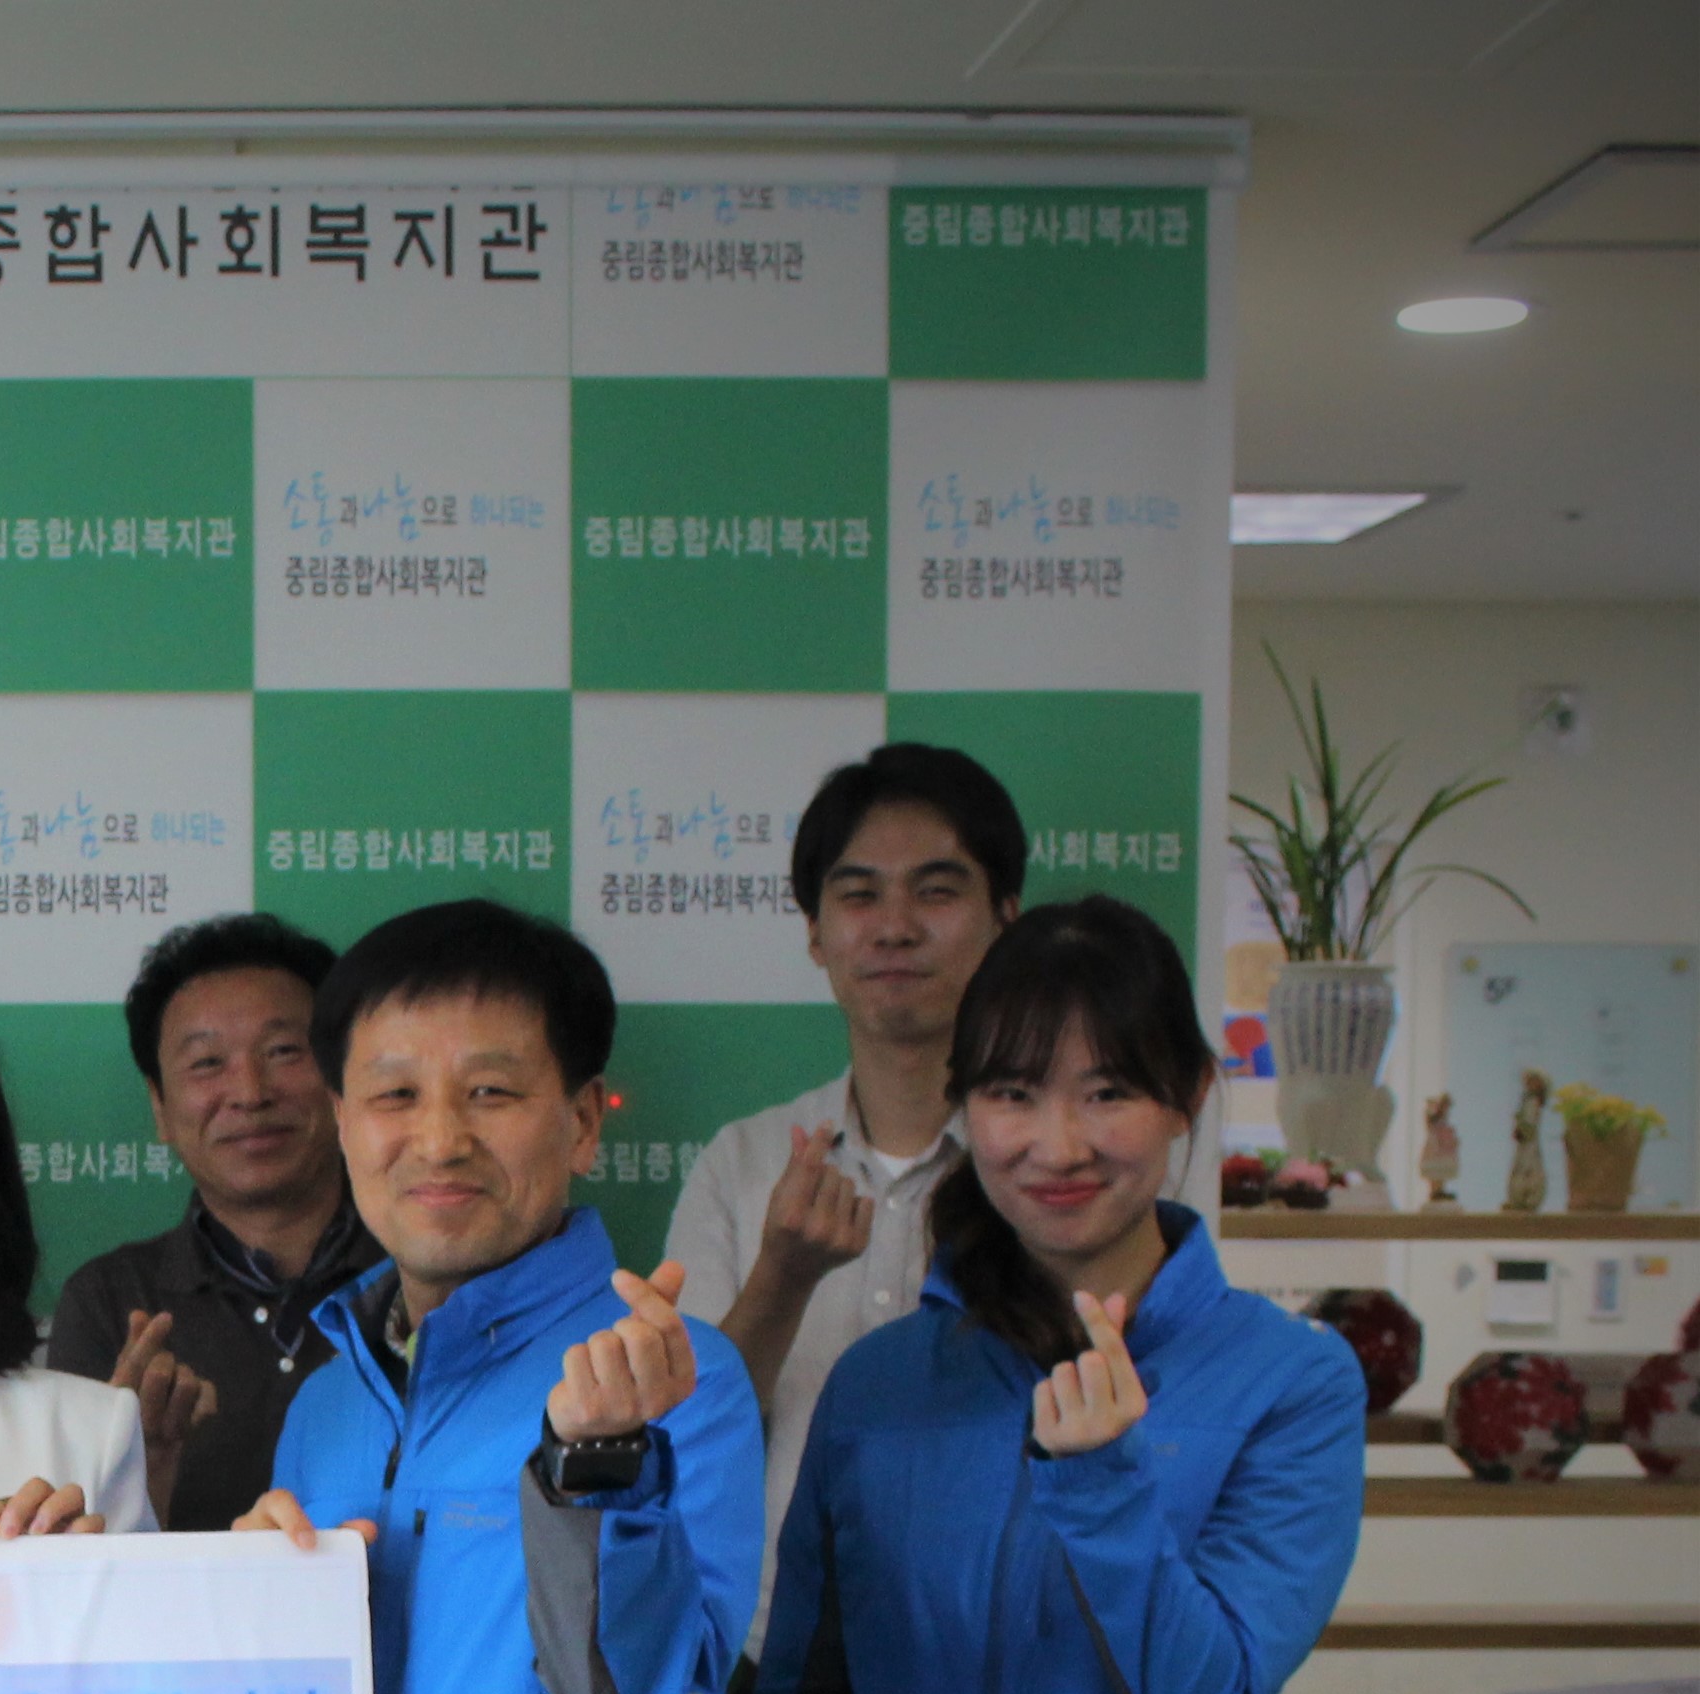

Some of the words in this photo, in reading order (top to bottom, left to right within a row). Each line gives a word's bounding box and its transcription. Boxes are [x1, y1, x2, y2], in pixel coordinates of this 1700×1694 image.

[900, 204, 1189, 247] 중림종합사회복지관
[602, 240, 805, 282] 중림종합사회복지관
[583, 516, 871, 558] 중림종합사회복지관
[285, 555, 488, 598] 중림종합사회복지관
[919, 557, 1124, 599] 중림종합사회복지관
[266, 829, 553, 872] 중림종합사회복지관
